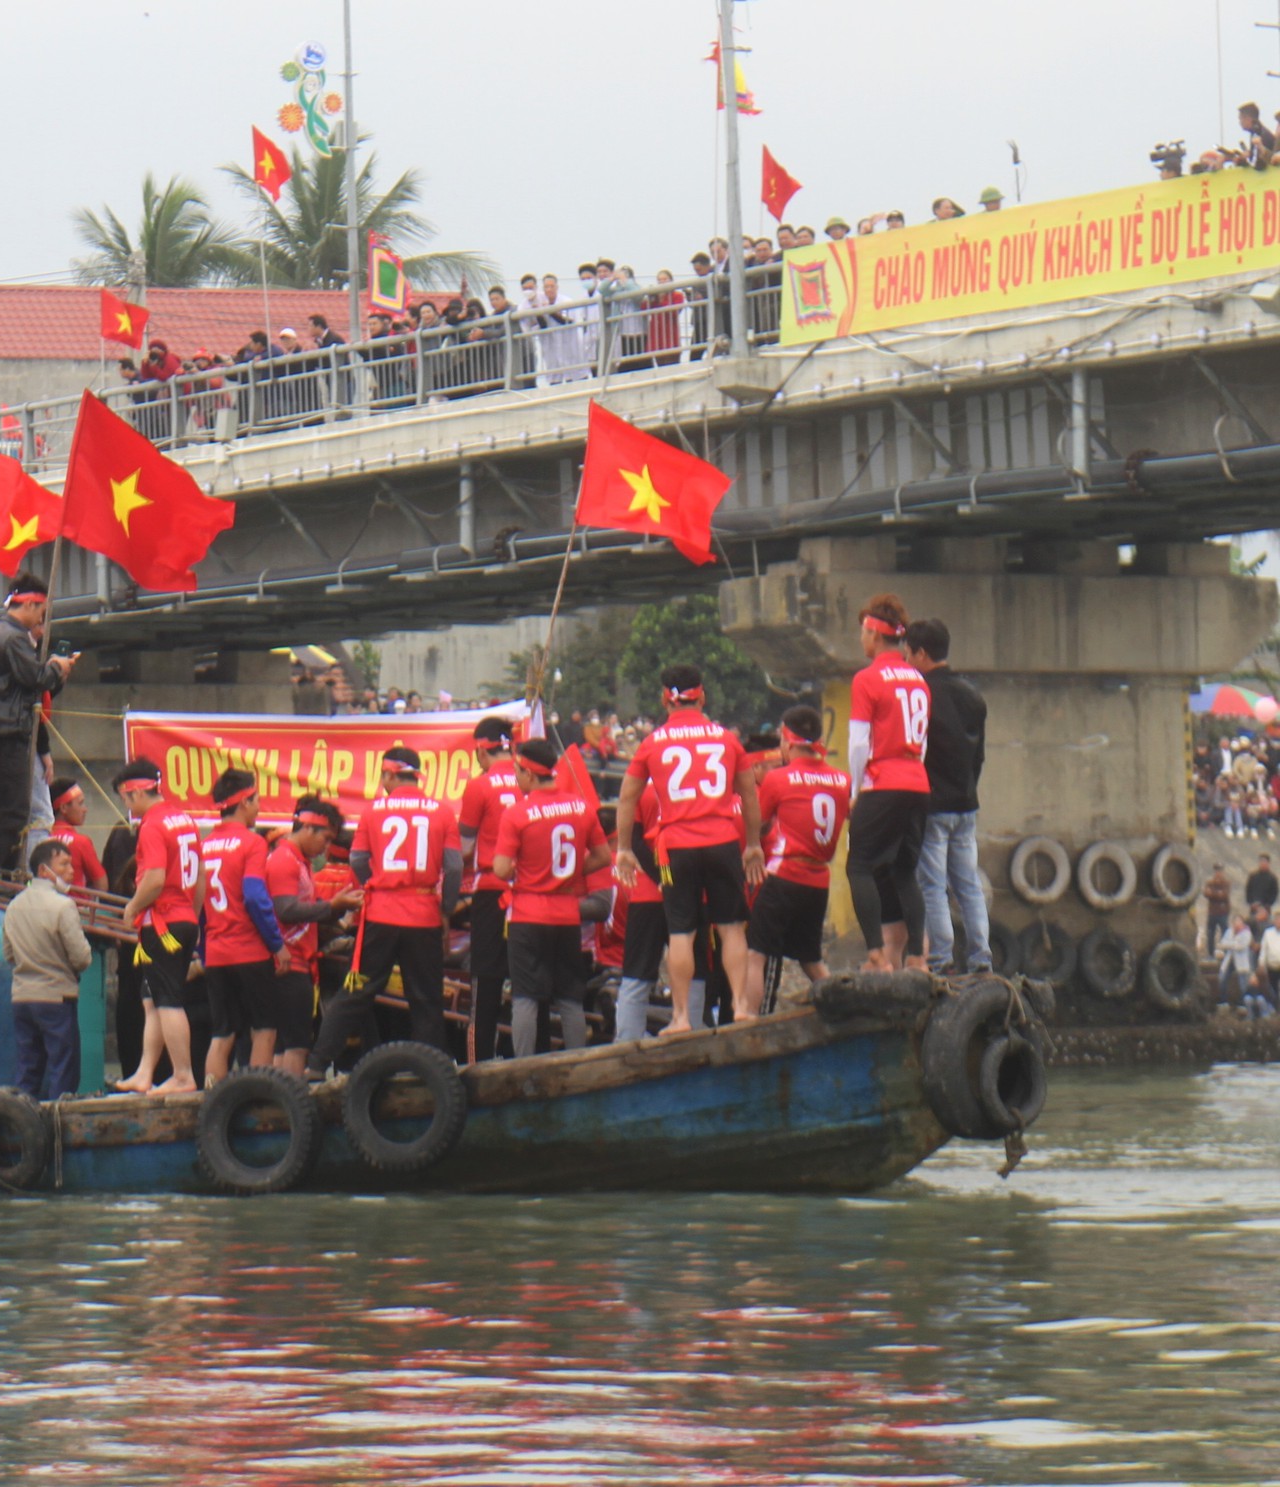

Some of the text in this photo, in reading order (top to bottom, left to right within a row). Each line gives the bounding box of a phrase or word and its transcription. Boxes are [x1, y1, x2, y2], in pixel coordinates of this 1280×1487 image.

[873, 180, 1280, 310] CHÀO MỪNG QUÝ KHÁCH VỀ DỰ LỄ HỘI Đ
[669, 726, 705, 739] QUỲNH
[895, 688, 928, 745] 18
[662, 744, 727, 802] 23
[542, 802, 572, 818] QUỲNH
[812, 793, 836, 845] 9
[382, 815, 429, 871] 21
[551, 824, 576, 878] 6
[205, 858, 228, 912] 3
